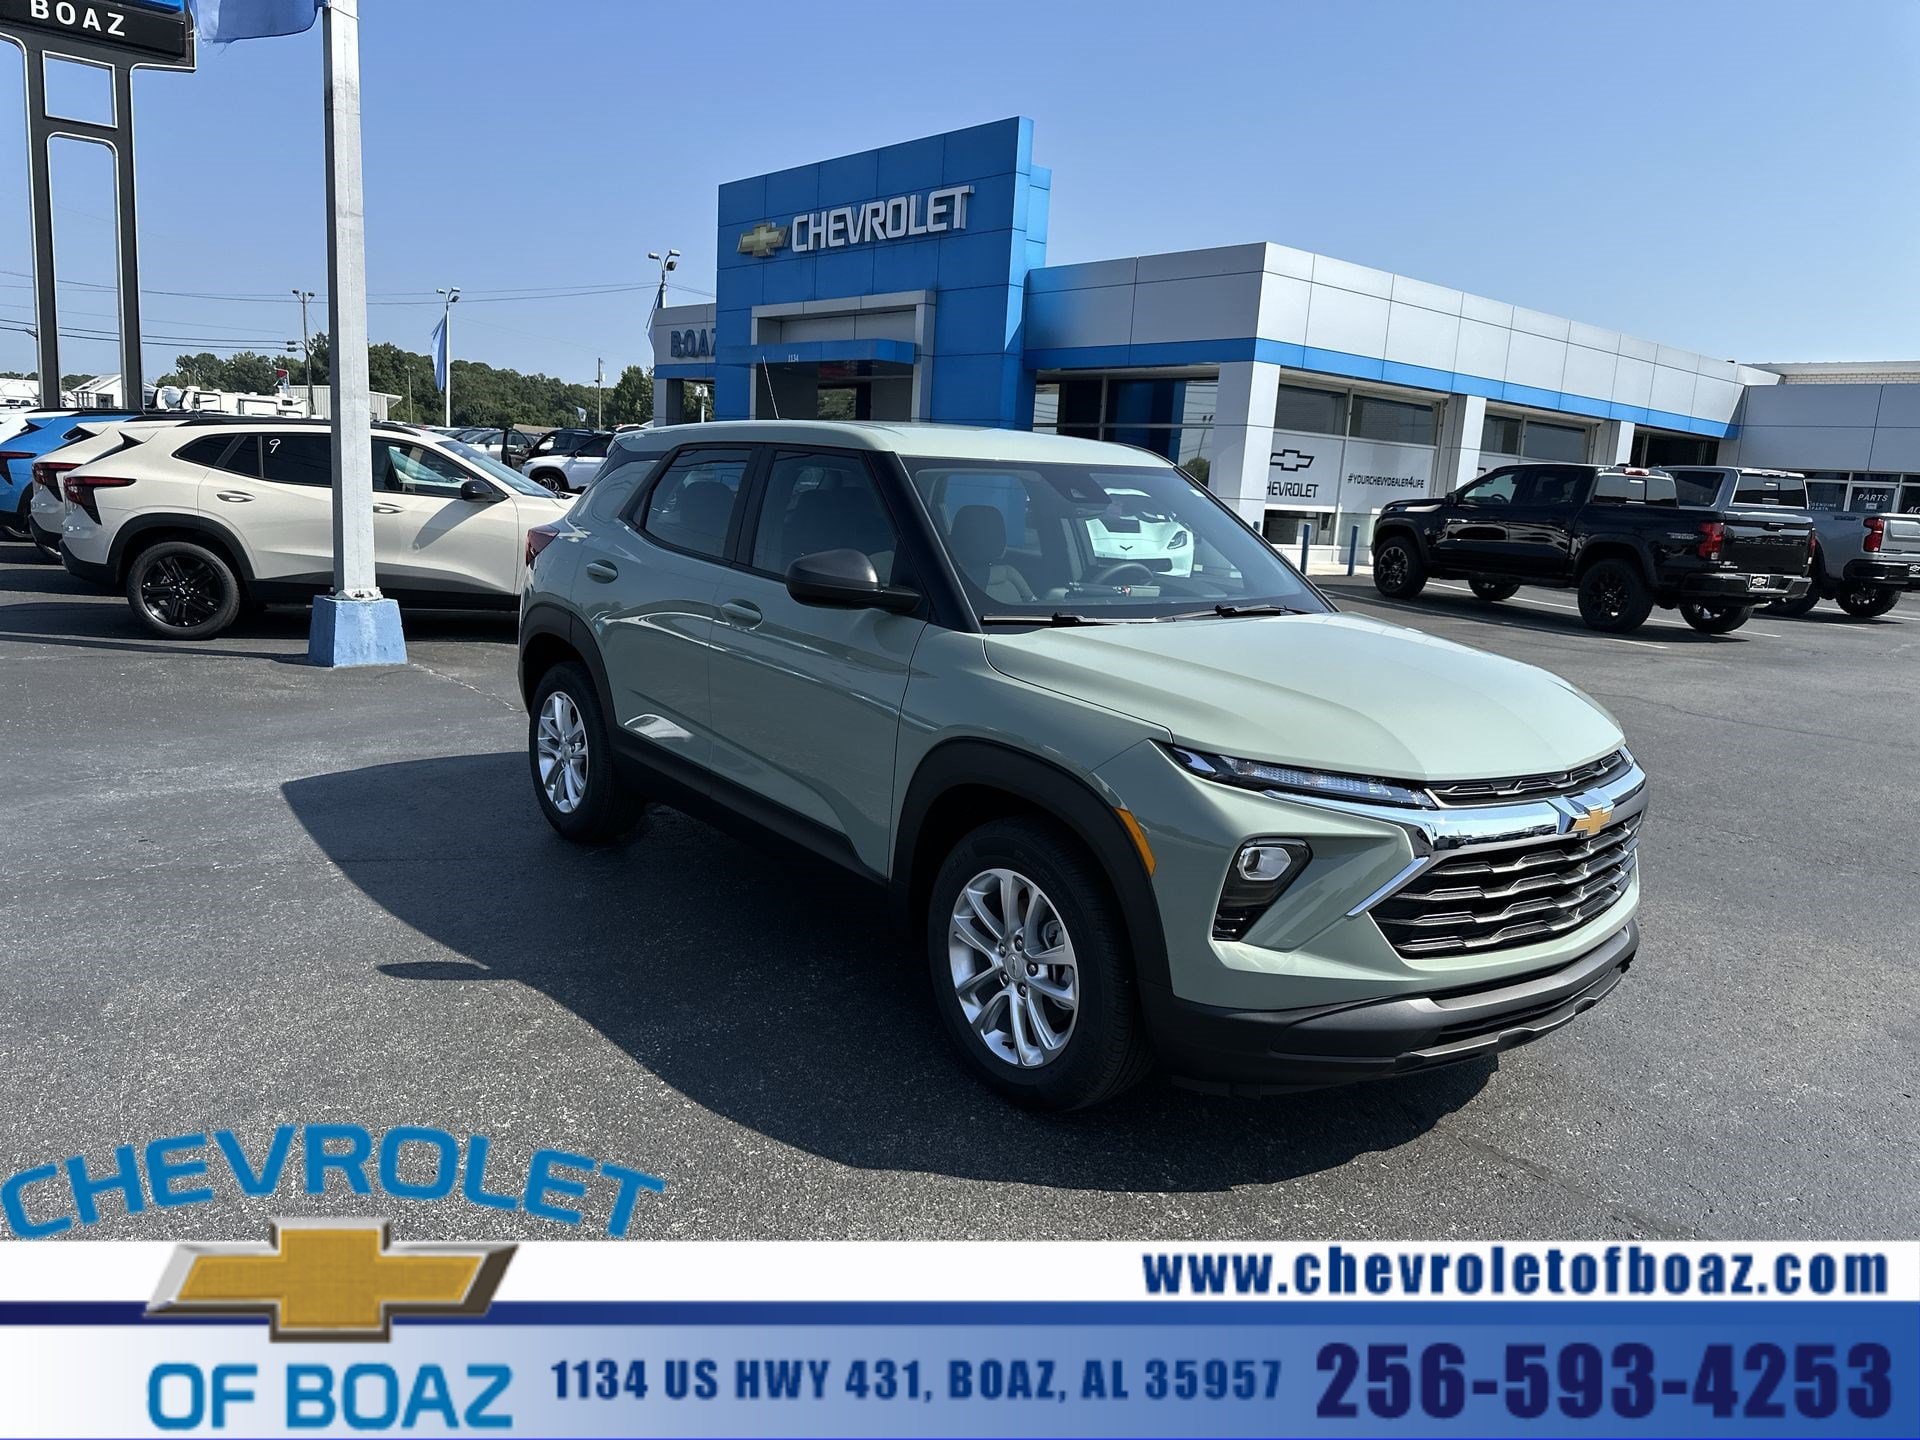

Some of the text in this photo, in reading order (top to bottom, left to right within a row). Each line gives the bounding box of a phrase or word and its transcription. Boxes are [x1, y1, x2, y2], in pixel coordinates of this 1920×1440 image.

[30, 0, 126, 37] BOAZ
[791, 187, 975, 252] CHEVROLET
[269, 438, 281, 454] 9
[1347, 473, 1424, 489] #YOURCHEVYDEALER4LIFE
[1266, 481, 1319, 498] HEVROLET
[1857, 493, 1889, 502] PARTS
